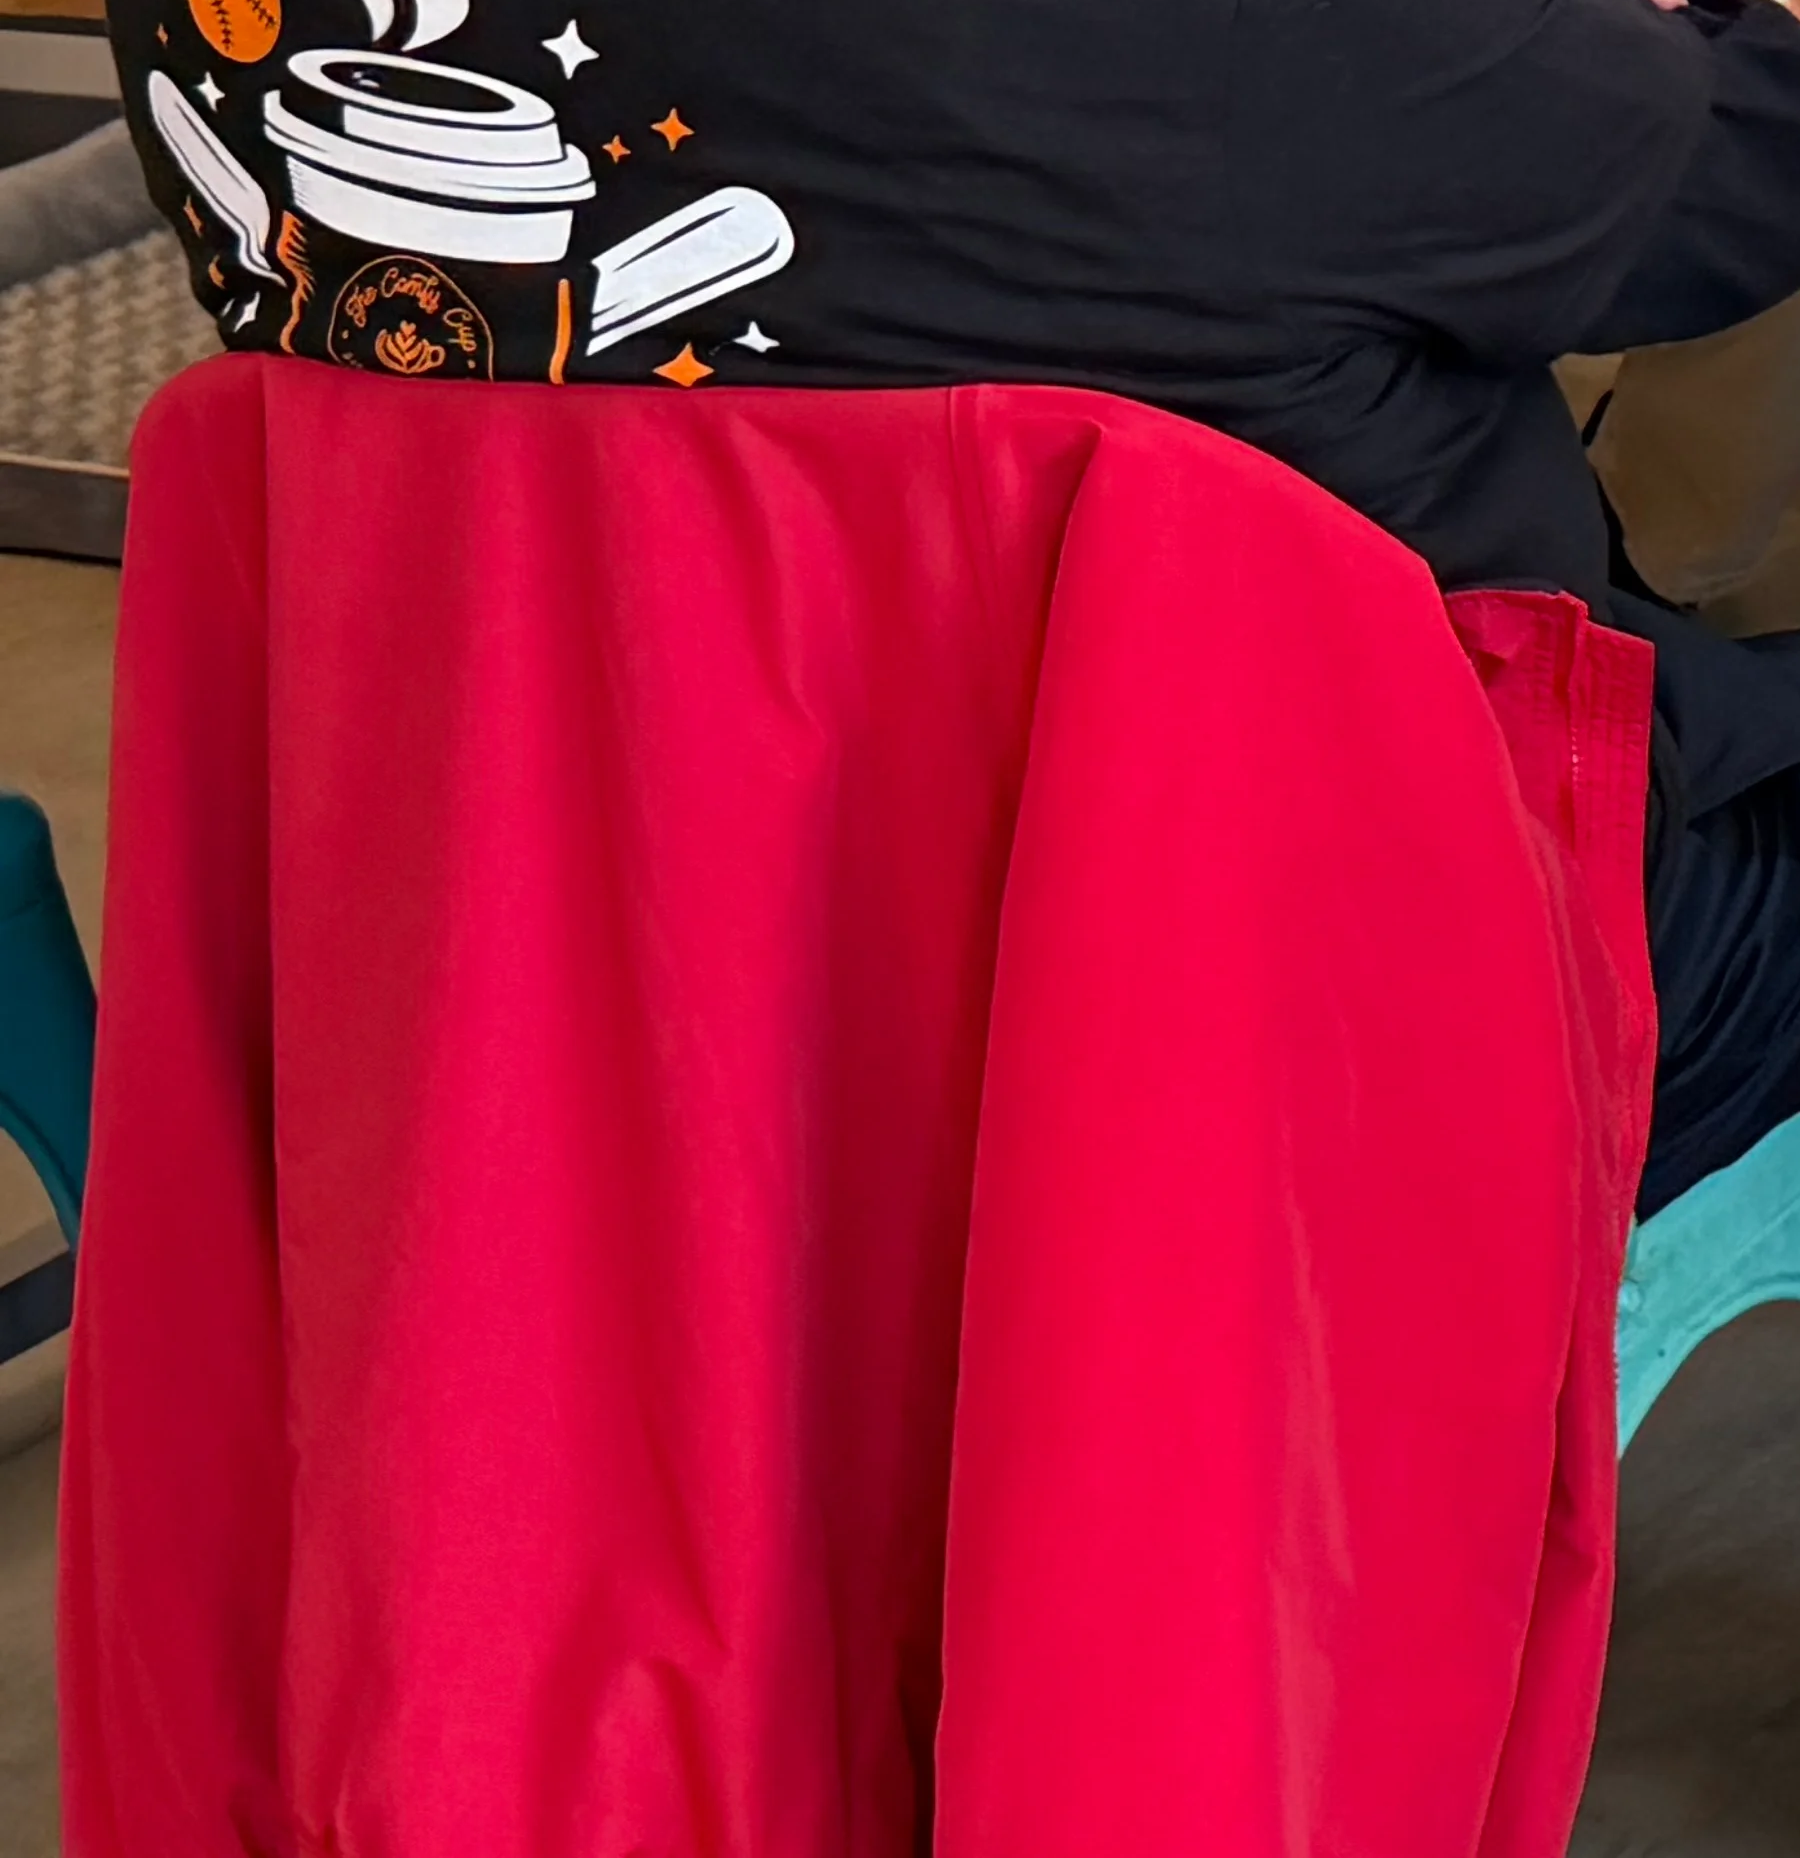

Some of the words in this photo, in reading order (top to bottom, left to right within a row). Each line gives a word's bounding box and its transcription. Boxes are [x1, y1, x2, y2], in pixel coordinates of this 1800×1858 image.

[345, 285, 378, 329] The
[381, 266, 441, 314] Comfy
[443, 307, 478, 352] Cup
